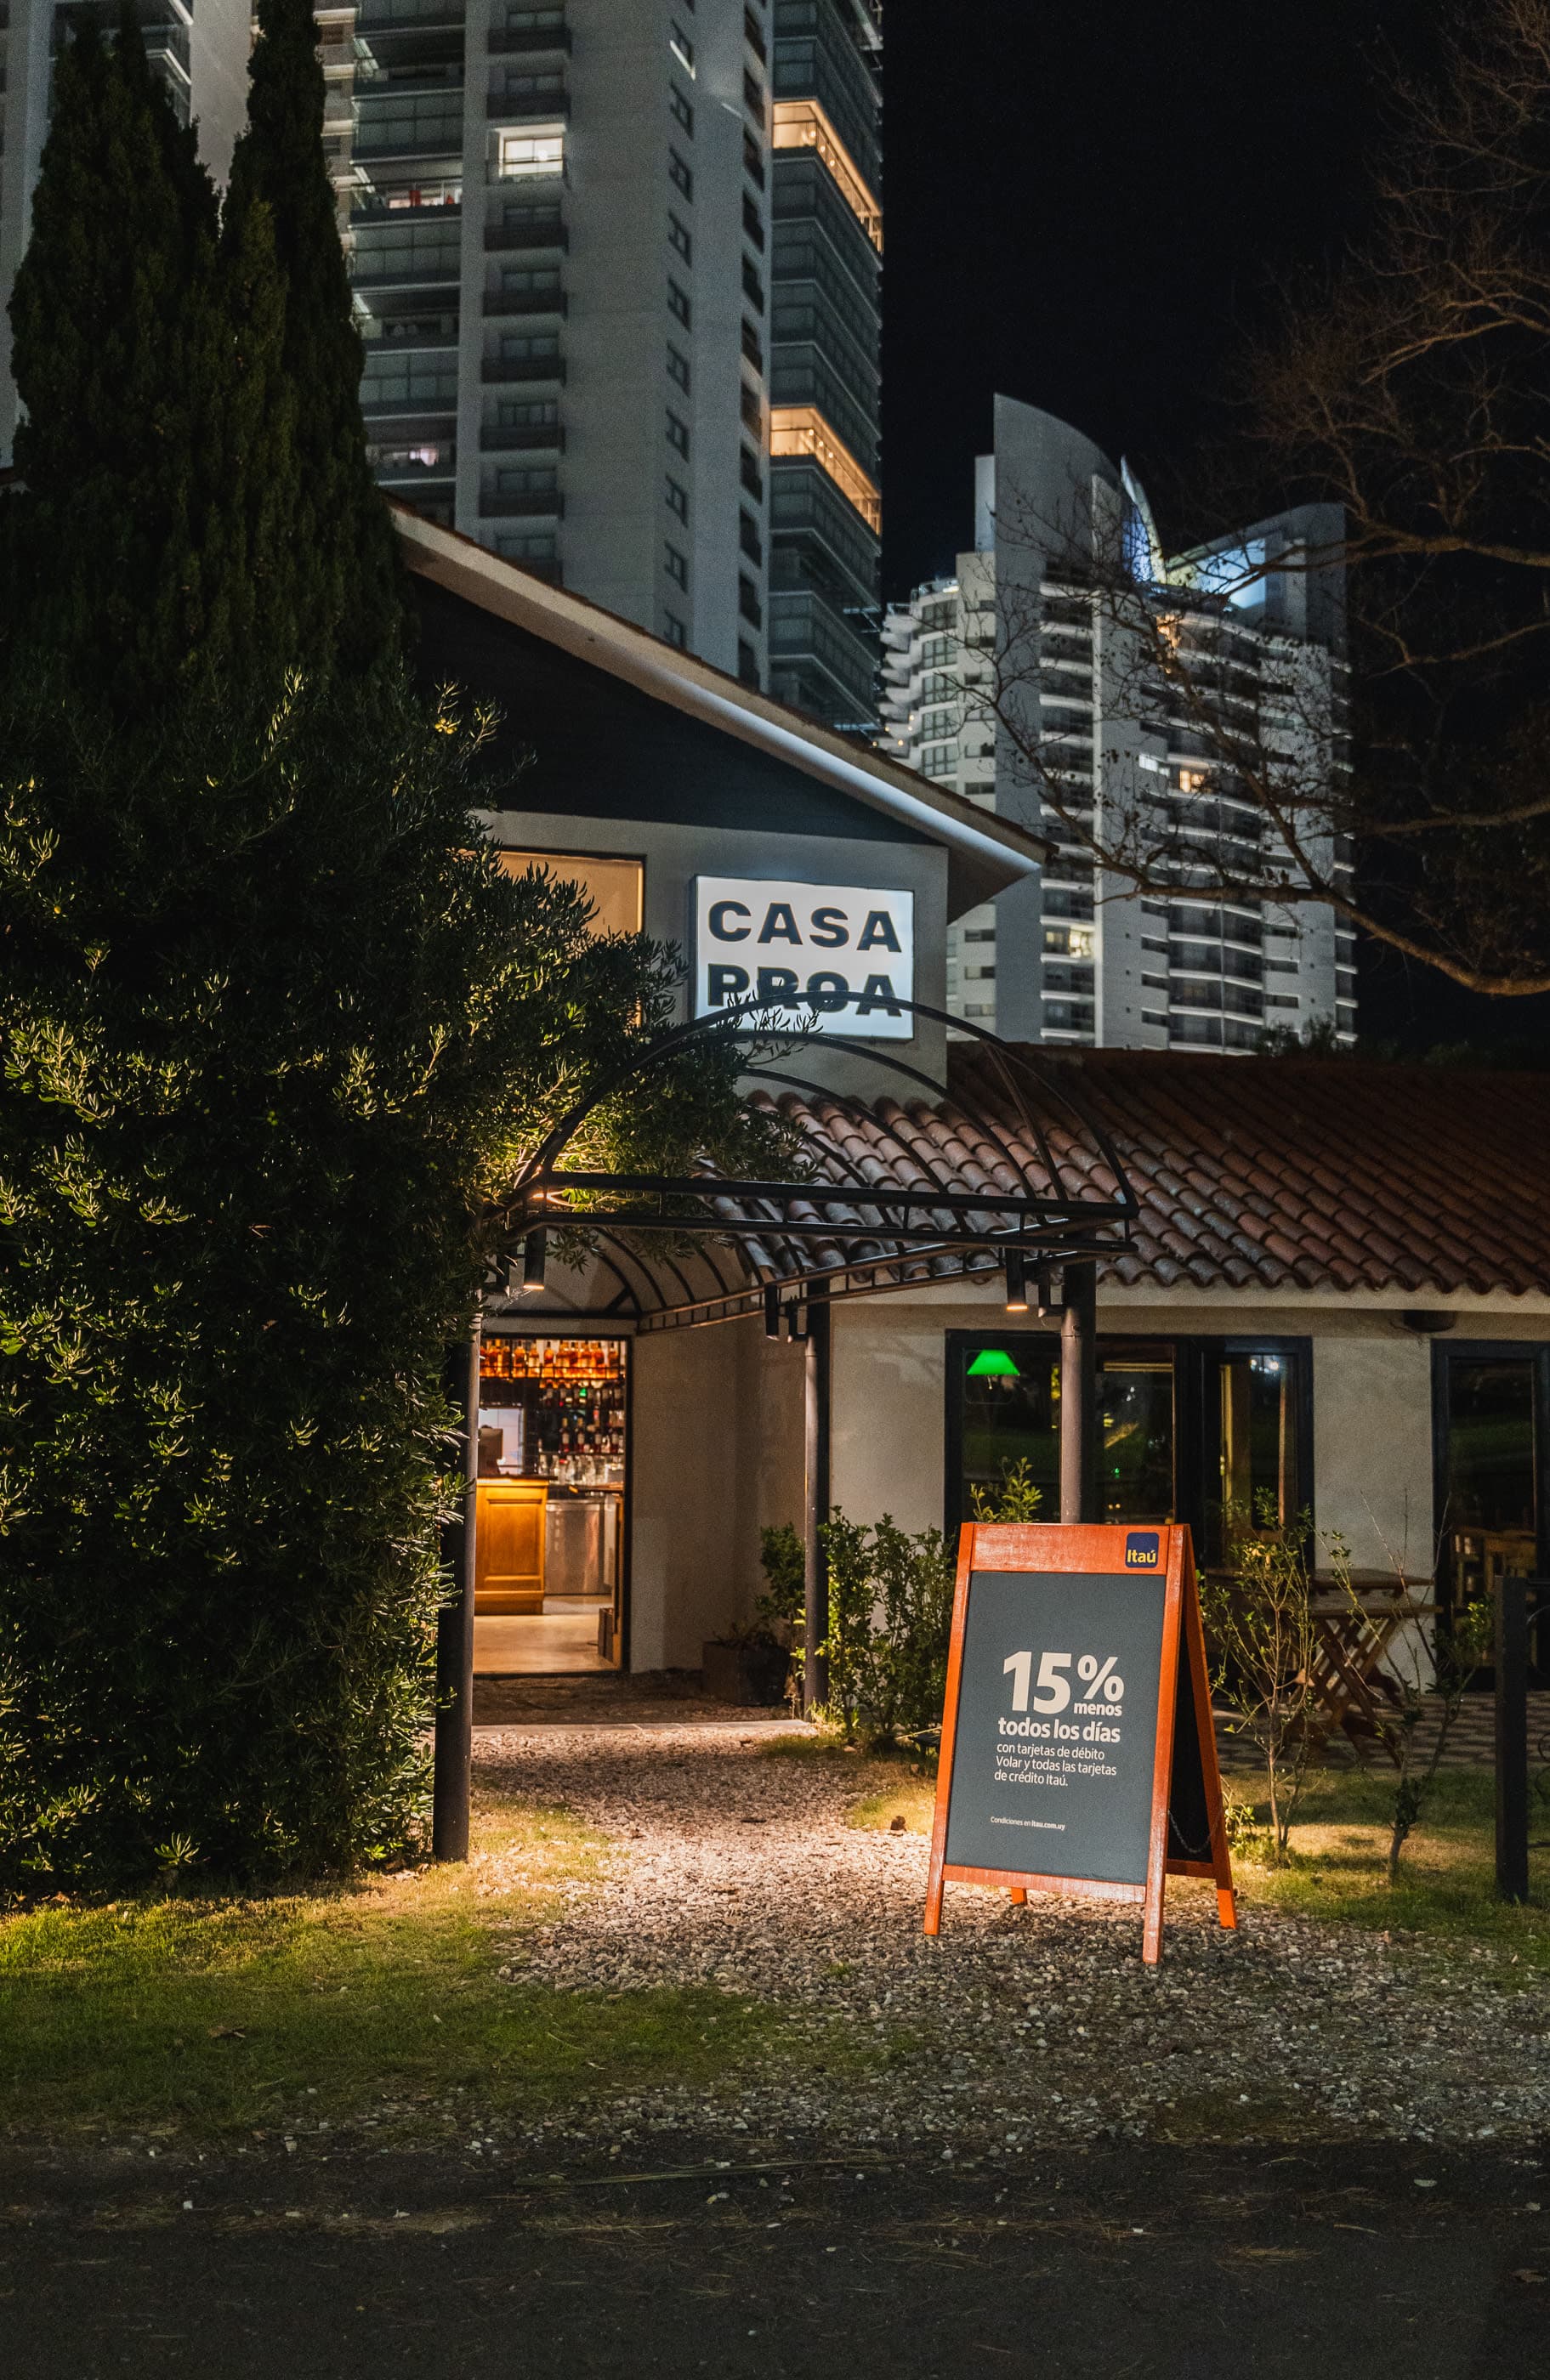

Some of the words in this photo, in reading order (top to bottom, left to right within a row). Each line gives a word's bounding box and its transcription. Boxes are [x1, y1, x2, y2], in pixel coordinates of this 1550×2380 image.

[707, 899, 903, 953] CASA
[707, 962, 903, 1017] PROA
[1127, 1549, 1156, 1563] Itaú
[1002, 1651, 1125, 1714] 15%
[1073, 1702, 1123, 1717] menos
[997, 1716, 1051, 1738] todos
[1053, 1719, 1080, 1740] los
[1082, 1720, 1121, 1743] días
[996, 1743, 1015, 1754] con
[1017, 1743, 1055, 1758] tarjetas
[1057, 1745, 1070, 1758] de
[1071, 1747, 1105, 1760] débito
[996, 1755, 1023, 1768] Volar
[1024, 1760, 1031, 1771] y
[1031, 1759, 1060, 1772] todas
[1062, 1760, 1076, 1773] las
[1077, 1761, 1117, 1776] tarjetas
[994, 1769, 1008, 1782] de
[1008, 1771, 1045, 1785] crédito
[1046, 1773, 1069, 1787] Itaú.
[990, 1816, 1023, 1827] Condiciones
